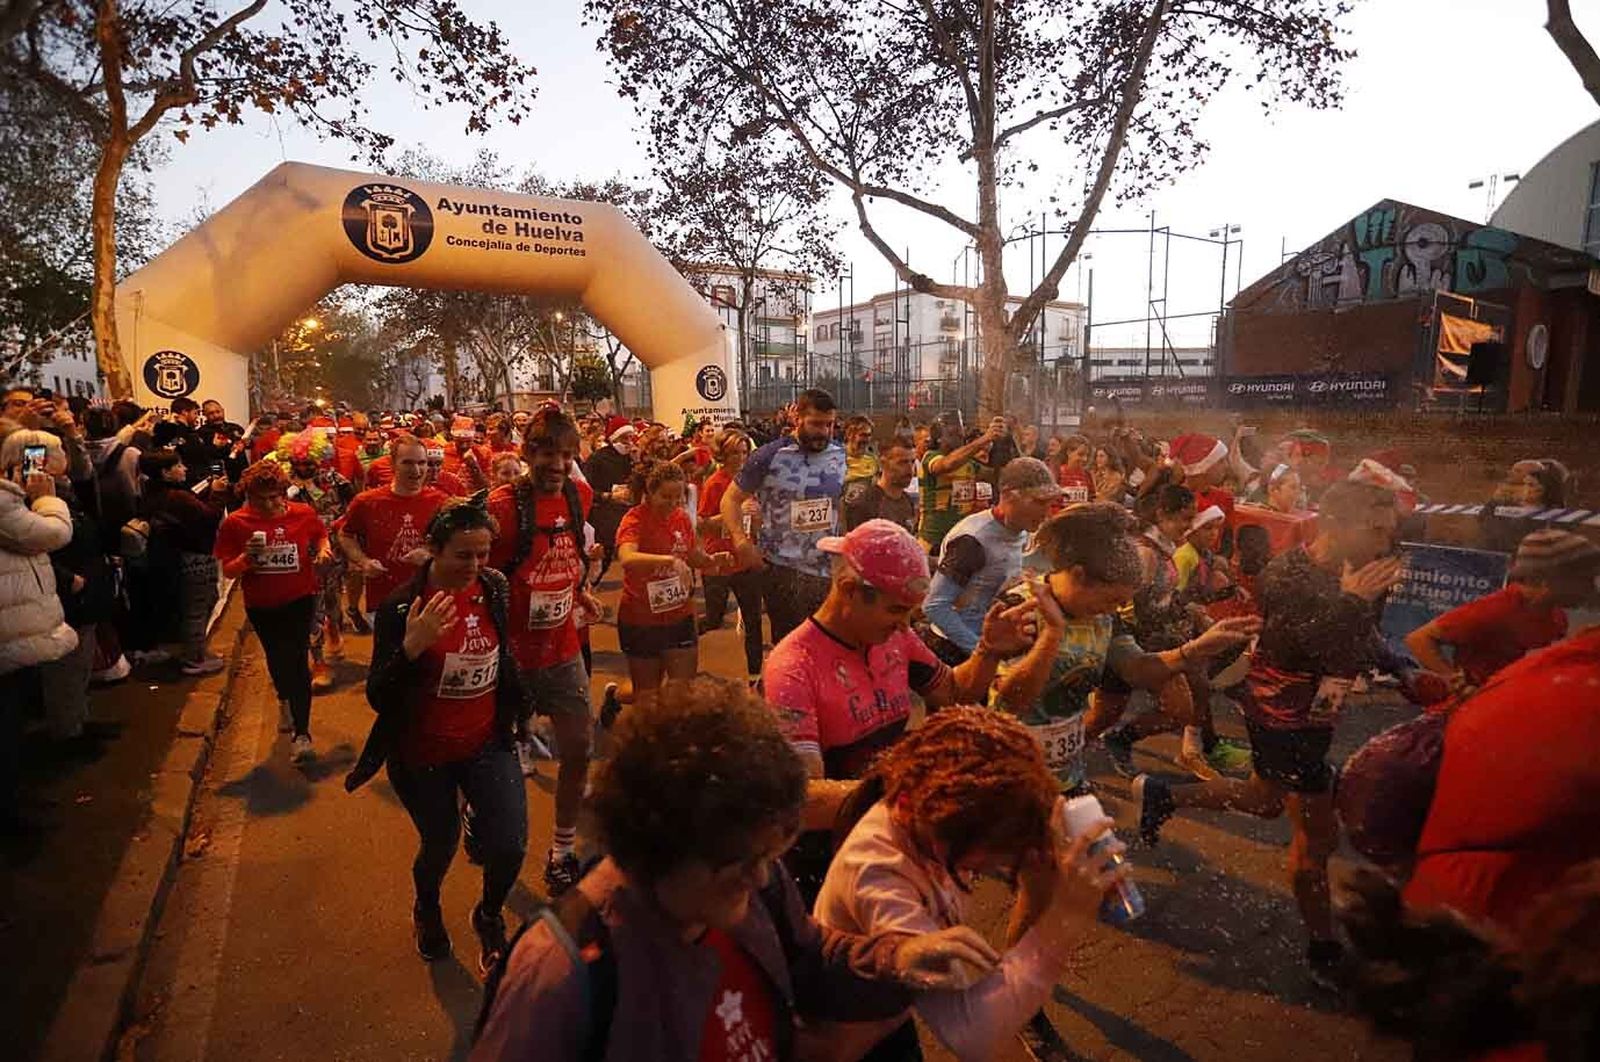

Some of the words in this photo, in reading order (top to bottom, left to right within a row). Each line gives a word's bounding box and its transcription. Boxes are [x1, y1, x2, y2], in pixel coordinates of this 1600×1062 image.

[436, 198, 583, 225] Ayuntamiento
[482, 218, 508, 235] de
[514, 220, 584, 242] Huelva
[515, 240, 531, 252] de
[534, 243, 586, 257] Deportes
[1246, 382, 1295, 393] HYUNDAI
[1329, 380, 1386, 391] HYUNDAI
[808, 507, 829, 522] 237
[270, 553, 295, 565] 446
[1412, 581, 1478, 603] Huelv
[471, 660, 498, 686] 517
